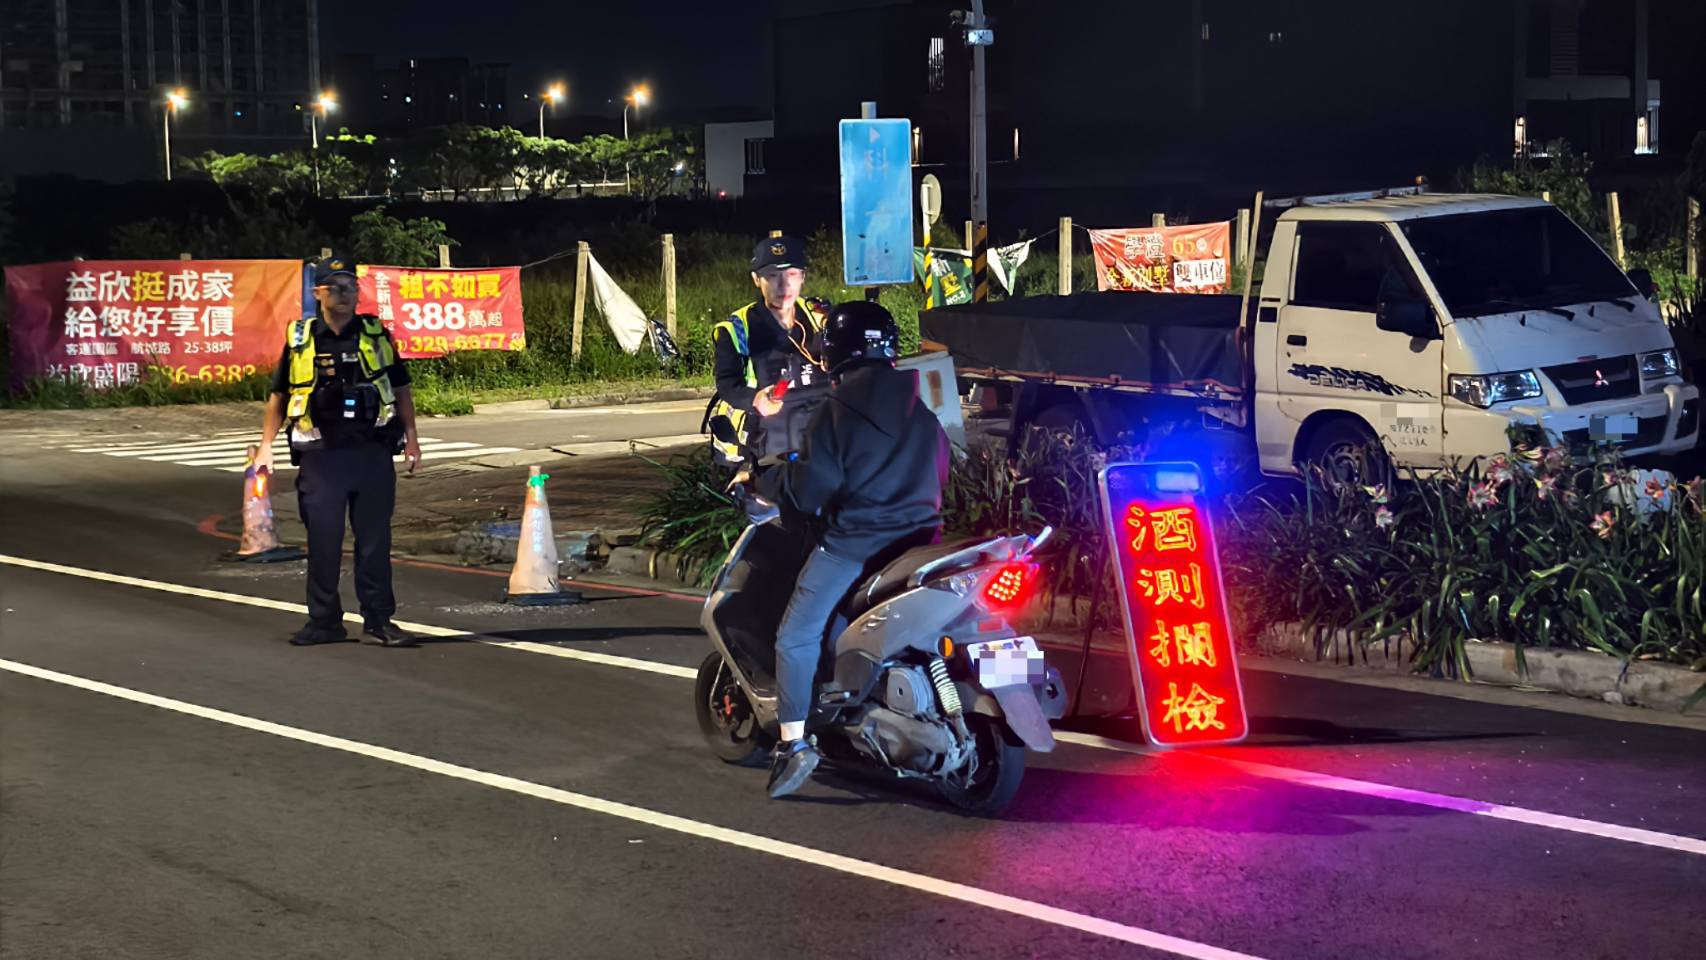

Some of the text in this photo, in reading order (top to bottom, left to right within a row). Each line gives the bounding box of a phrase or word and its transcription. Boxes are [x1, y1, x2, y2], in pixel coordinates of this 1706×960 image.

[65, 270, 235, 302] 益欣挺成家
[400, 272, 501, 299] 租不如買
[64, 305, 235, 338] 給您好享價
[1127, 506, 1226, 734] 酒測攔檢
